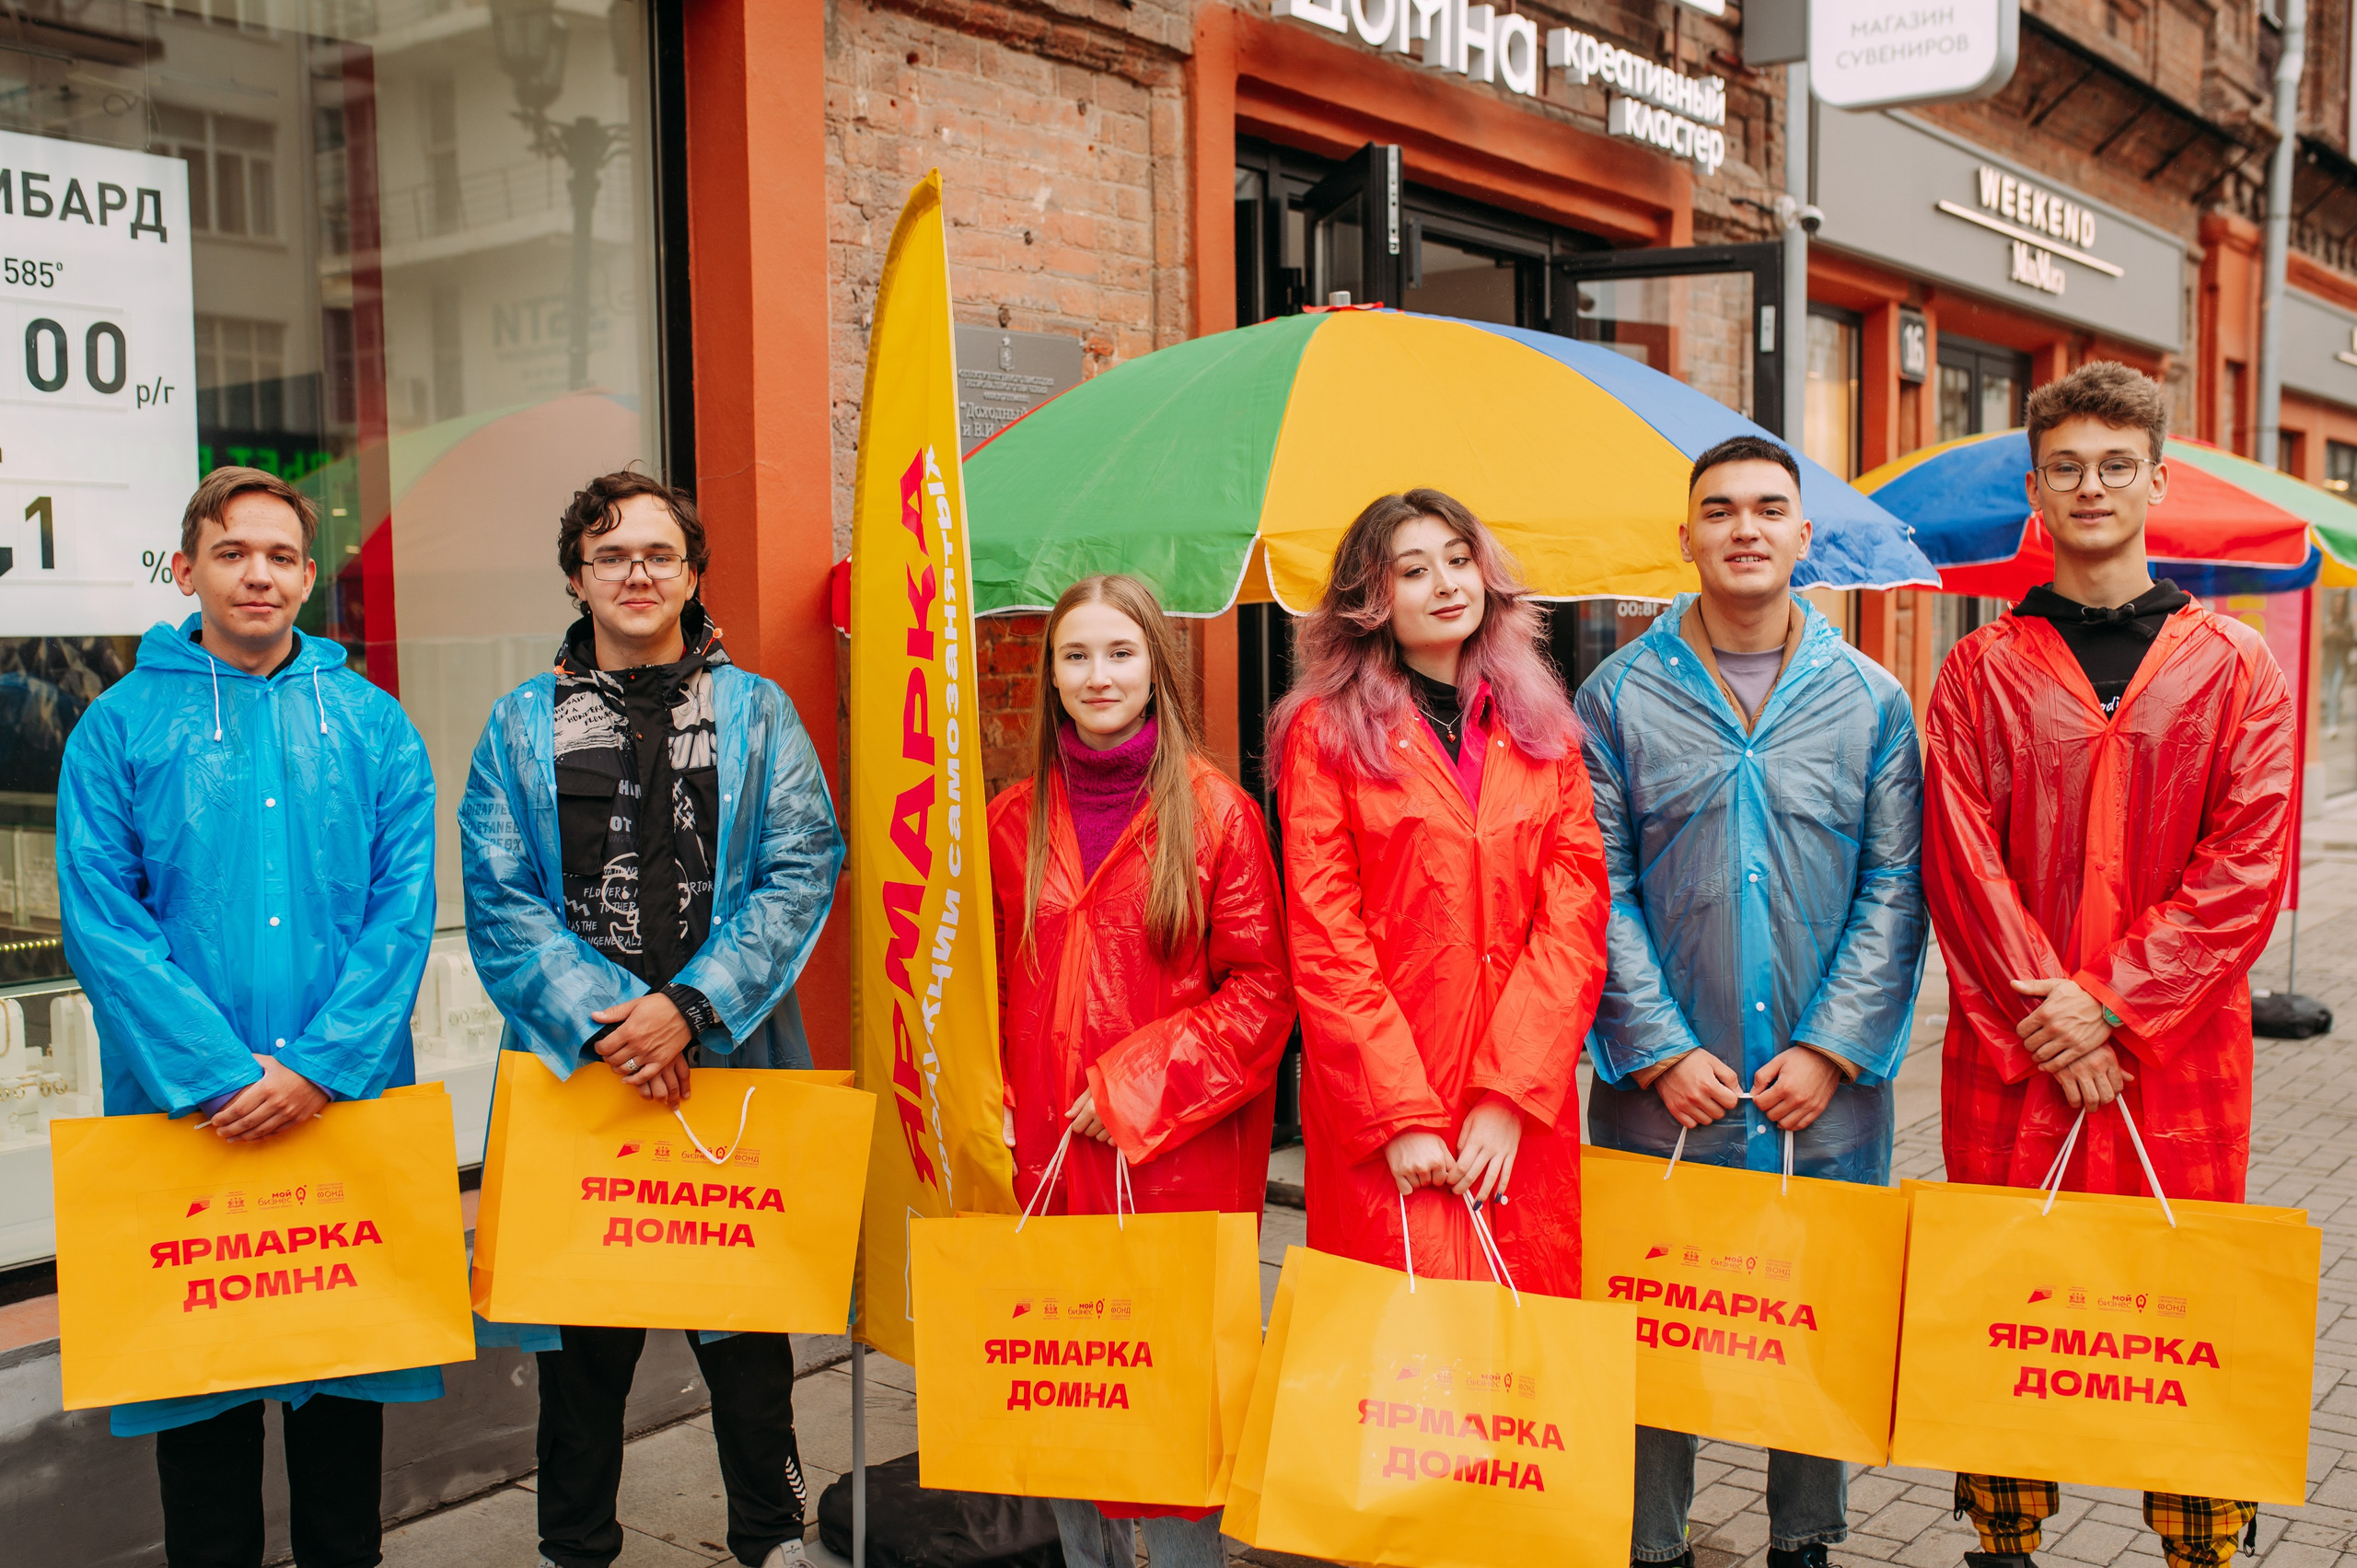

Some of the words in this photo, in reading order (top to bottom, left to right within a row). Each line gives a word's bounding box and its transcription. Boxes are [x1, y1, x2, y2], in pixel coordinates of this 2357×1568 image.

[1850, 7, 1956, 39] МАГАЗИН
[1835, 34, 1970, 70] СУВЕНИРОВ
[1563, 27, 1727, 126] креативный
[1624, 97, 1726, 176] кластер
[1980, 165, 2096, 249] WEEKEND
[1903, 323, 1926, 373] 16
[136, 376, 175, 410] р/г
[925, 443, 962, 877] самозанятых
[566, 693, 586, 705] SAID
[882, 446, 938, 1194] ЯРМАРКА
[581, 921, 598, 932] THE
[681, 1150, 708, 1160] бизне
[734, 1155, 760, 1164] ФОНД
[258, 1197, 293, 1206] бизнес
[272, 1189, 292, 1199] мой
[317, 1190, 344, 1199] ФОНД
[581, 1176, 785, 1213] ЯРМАРКА
[149, 1219, 384, 1269] ЯРМАРКА
[602, 1216, 756, 1249] ДОМНА
[1710, 1257, 1743, 1270] бизнес
[1724, 1256, 1743, 1264] мой
[1765, 1266, 1791, 1276] ФОНД
[182, 1262, 358, 1313] ДОМНА
[1608, 1275, 1818, 1331] ЯРМАРКА
[2097, 1297, 2132, 1309] бизнес
[2111, 1294, 2132, 1303] мой
[1068, 1307, 1094, 1316] бизнес
[1078, 1301, 1094, 1309] мой
[1110, 1307, 1132, 1315] ФОНД
[2157, 1304, 2187, 1314] ФОНД
[984, 1339, 1154, 1368] ЯРМАРКА
[1636, 1317, 1787, 1366] ДОМНА
[1988, 1322, 2221, 1369] ЯРМАРКА
[1466, 1376, 1502, 1388] бизнес
[1480, 1372, 1501, 1381] мой
[2014, 1365, 2189, 1408] ДОМНА
[1006, 1379, 1130, 1411] ДОМНА
[1357, 1398, 1565, 1452] ЯРМАРКА
[1382, 1446, 1545, 1493] ДОМНА
